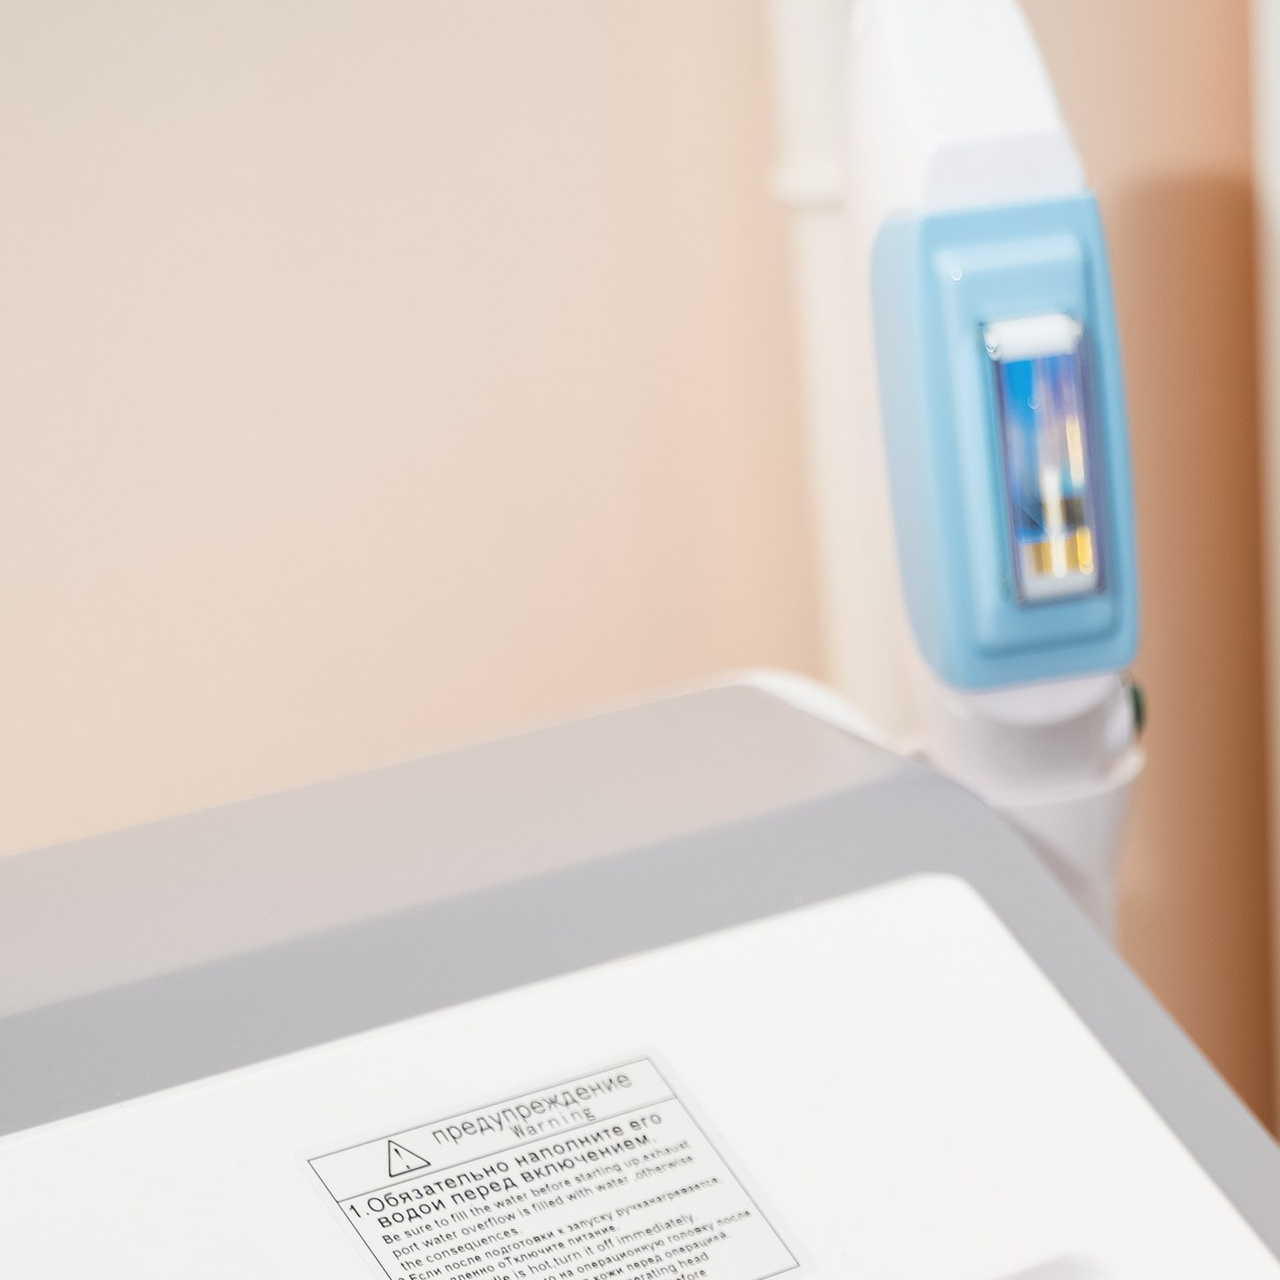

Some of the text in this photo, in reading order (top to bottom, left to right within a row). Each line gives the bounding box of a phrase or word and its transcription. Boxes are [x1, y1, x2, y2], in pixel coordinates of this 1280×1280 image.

[432, 1072, 631, 1144] предупреждение
[509, 1104, 596, 1139] Warning
[514, 1126, 623, 1166] наполните
[629, 1114, 662, 1131] его
[381, 1234, 401, 1245] Be
[403, 1223, 433, 1238] sure
[433, 1218, 449, 1228] to
[450, 1210, 469, 1223] fill
[469, 1205, 492, 1217] the
[493, 1192, 527, 1209] water
[529, 1179, 572, 1197] before
[574, 1163, 623, 1184] starting
[450, 1177, 518, 1205] перед
[392, 1242, 420, 1260] port
[421, 1231, 457, 1248] water
[461, 1212, 516, 1235] overflow
[517, 1208, 531, 1217] is
[531, 1195, 564, 1212] filled
[565, 1187, 593, 1201] with
[594, 1176, 628, 1192] water
[400, 1228, 520, 1271] the consequences.
[444, 1255, 482, 1272] после
[484, 1231, 555, 1258] подготовки
[567, 1212, 613, 1232] запуску
[512, 1270, 527, 1279] is
[583, 1246, 595, 1256] it
[596, 1238, 614, 1252] off
[558, 1269, 574, 1279] на
[576, 1239, 665, 1273] операционную
[667, 1223, 714, 1242] головку
[716, 1210, 751, 1226] после
[626, 1254, 663, 1271] перед
[677, 1251, 709, 1268] head
